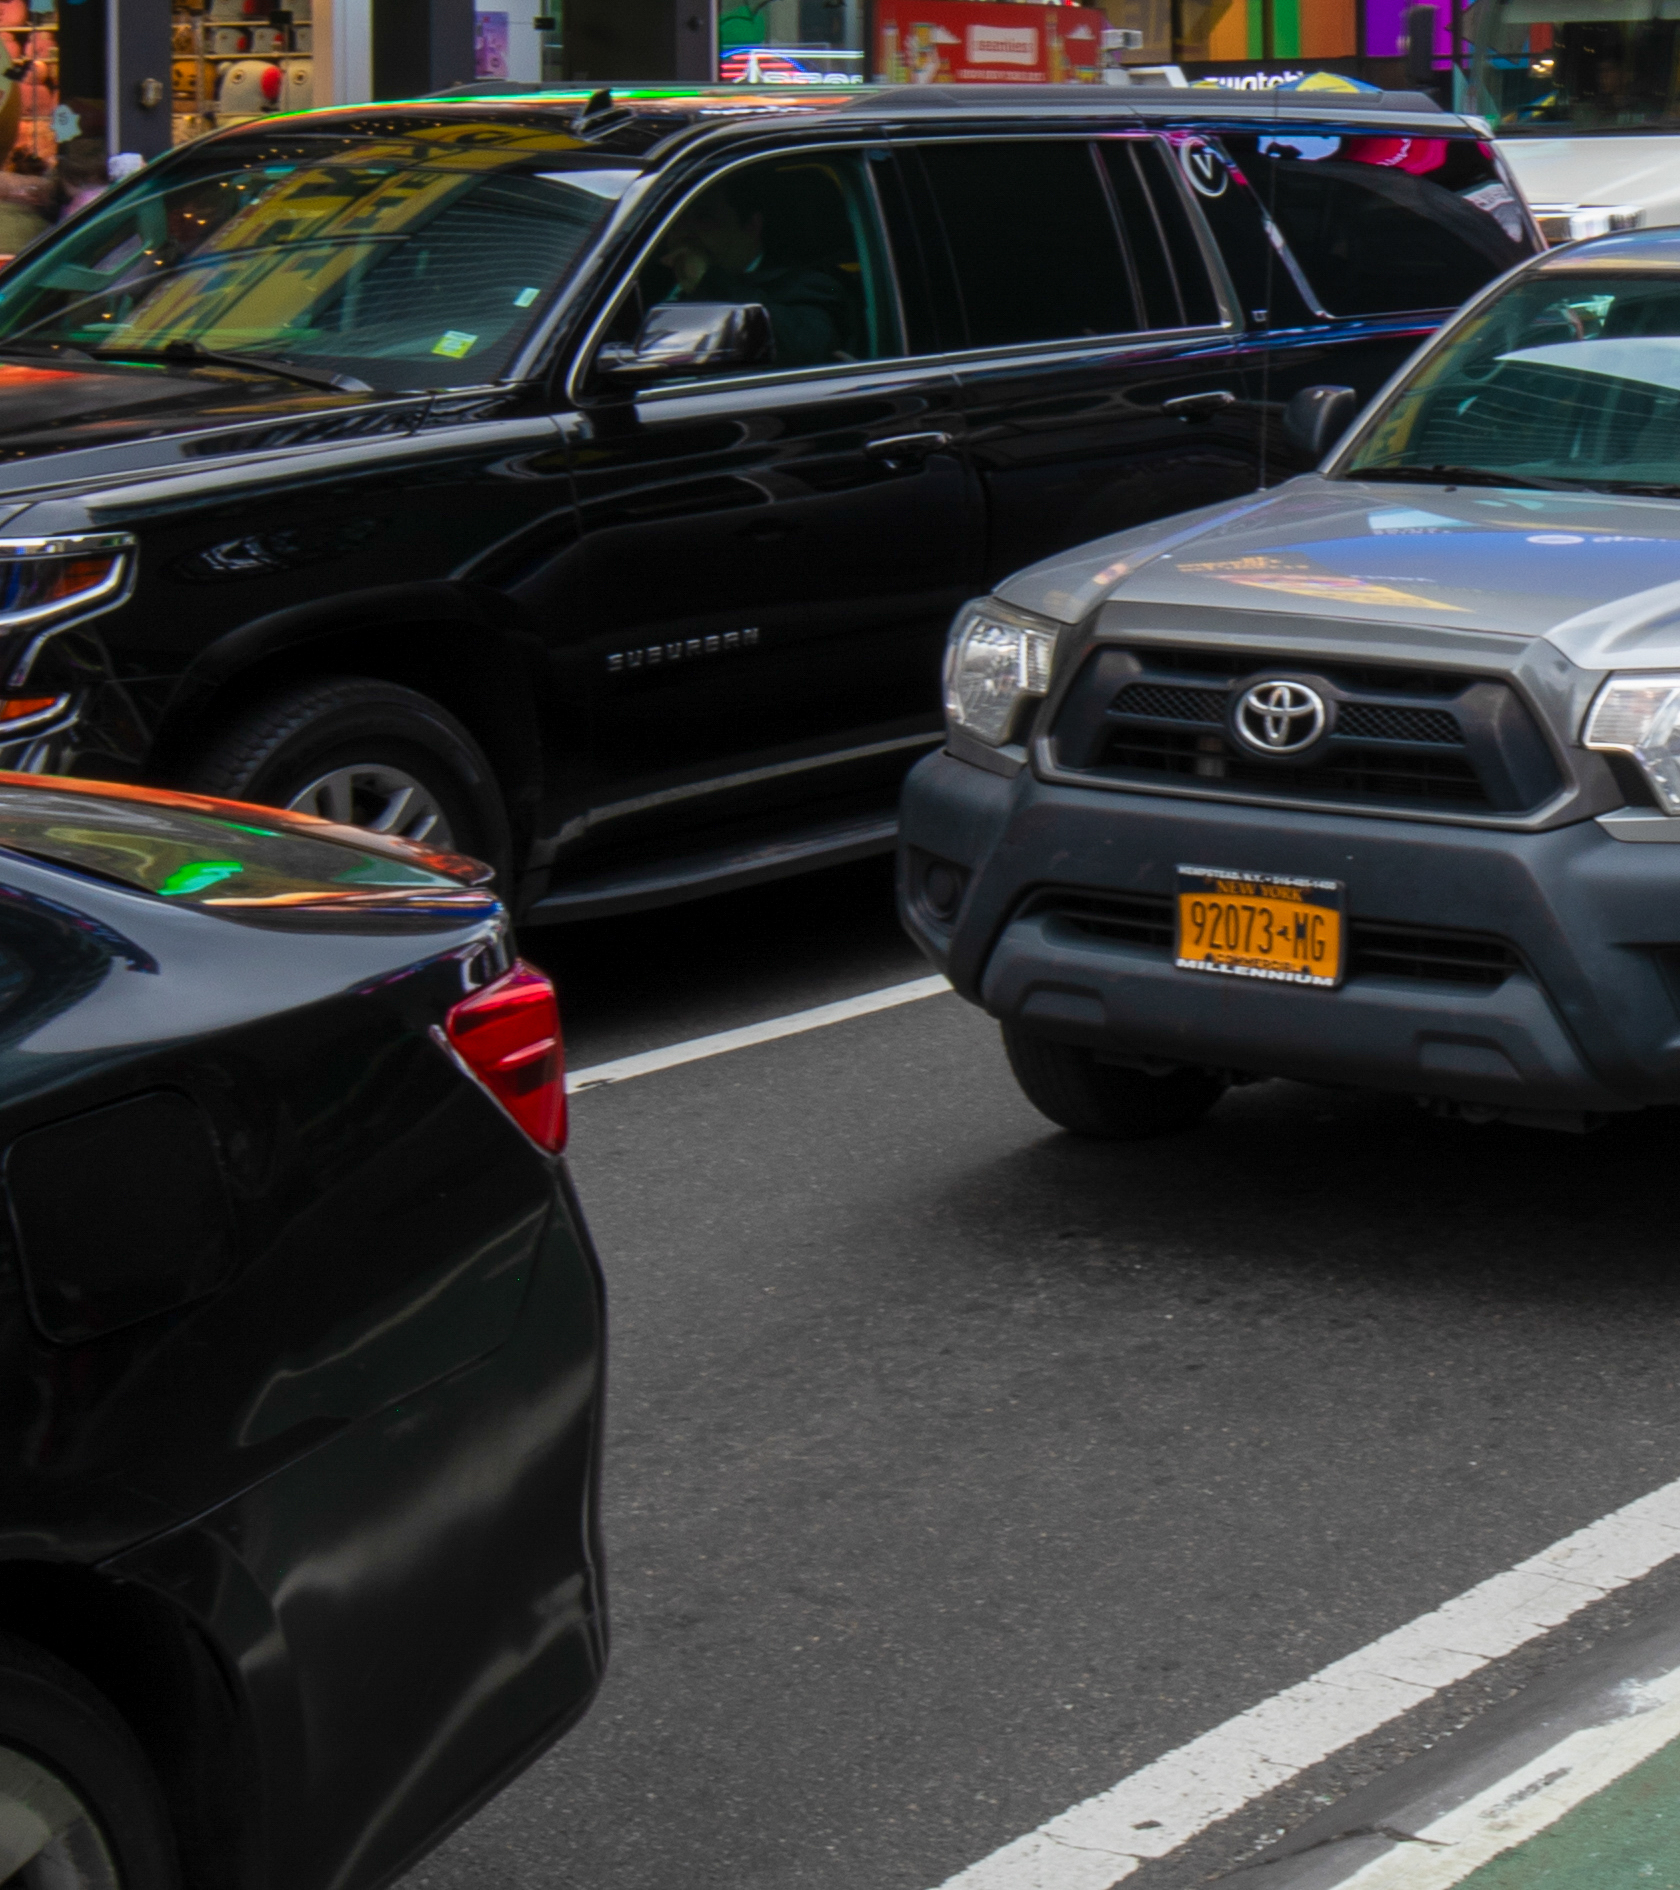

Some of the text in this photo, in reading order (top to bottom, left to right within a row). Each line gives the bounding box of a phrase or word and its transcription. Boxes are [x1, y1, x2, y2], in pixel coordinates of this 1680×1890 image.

[607, 626, 761, 673] SUBURBAN
[1261, 885, 1304, 903] YORK
[1191, 900, 1273, 954] 92073
[1175, 958, 1335, 987] MILLENNIUM
